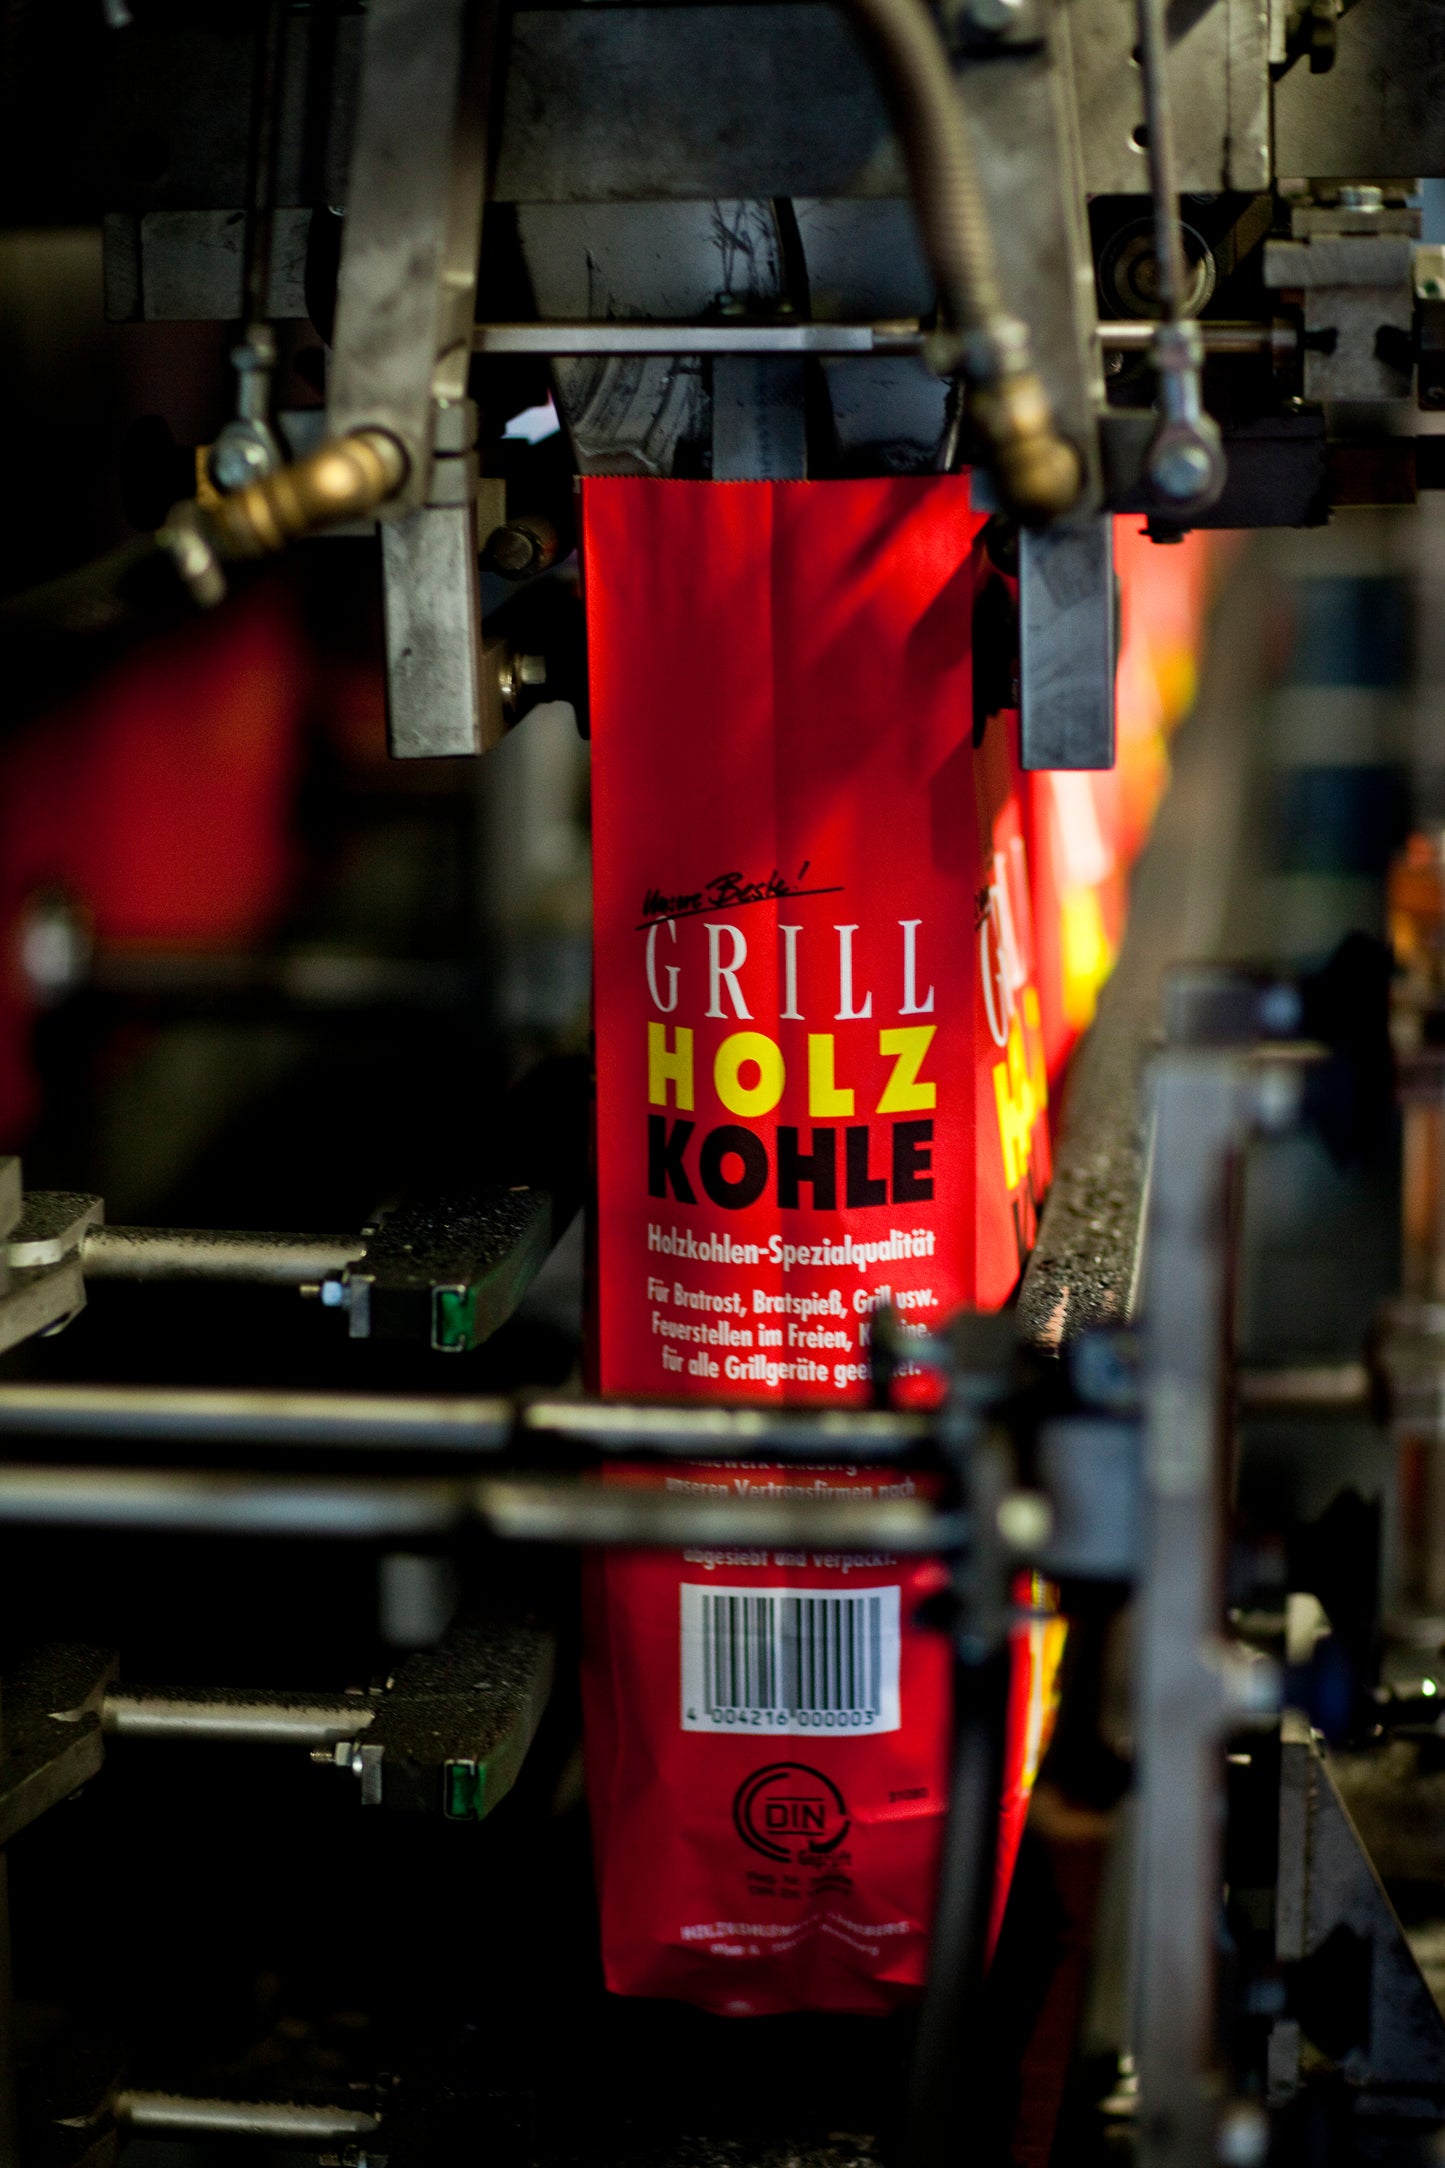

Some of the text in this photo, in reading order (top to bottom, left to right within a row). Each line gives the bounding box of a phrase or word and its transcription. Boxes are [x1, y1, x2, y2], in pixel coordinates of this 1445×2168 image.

[706, 860, 811, 906] Beste!
[645, 914, 935, 1021] GRILL
[647, 1021, 938, 1118] HOLZ
[647, 1113, 935, 1211] KOHLE
[648, 1223, 935, 1272] Holzkohlen-Spezialqualität
[647, 1277, 669, 1302] Für
[673, 1282, 747, 1317] Bratrost,
[753, 1289, 848, 1321] Bratspieß,
[895, 1288, 939, 1309] usw.
[652, 1311, 753, 1347] Feuerstellen
[758, 1323, 783, 1347] im
[788, 1323, 853, 1352] Freien,
[662, 1345, 683, 1372] für
[688, 1351, 719, 1378] alle
[725, 1353, 828, 1387] Grillgeräte
[686, 1706, 875, 1727] 4 004216 000003
[765, 1803, 825, 1829] DIN
